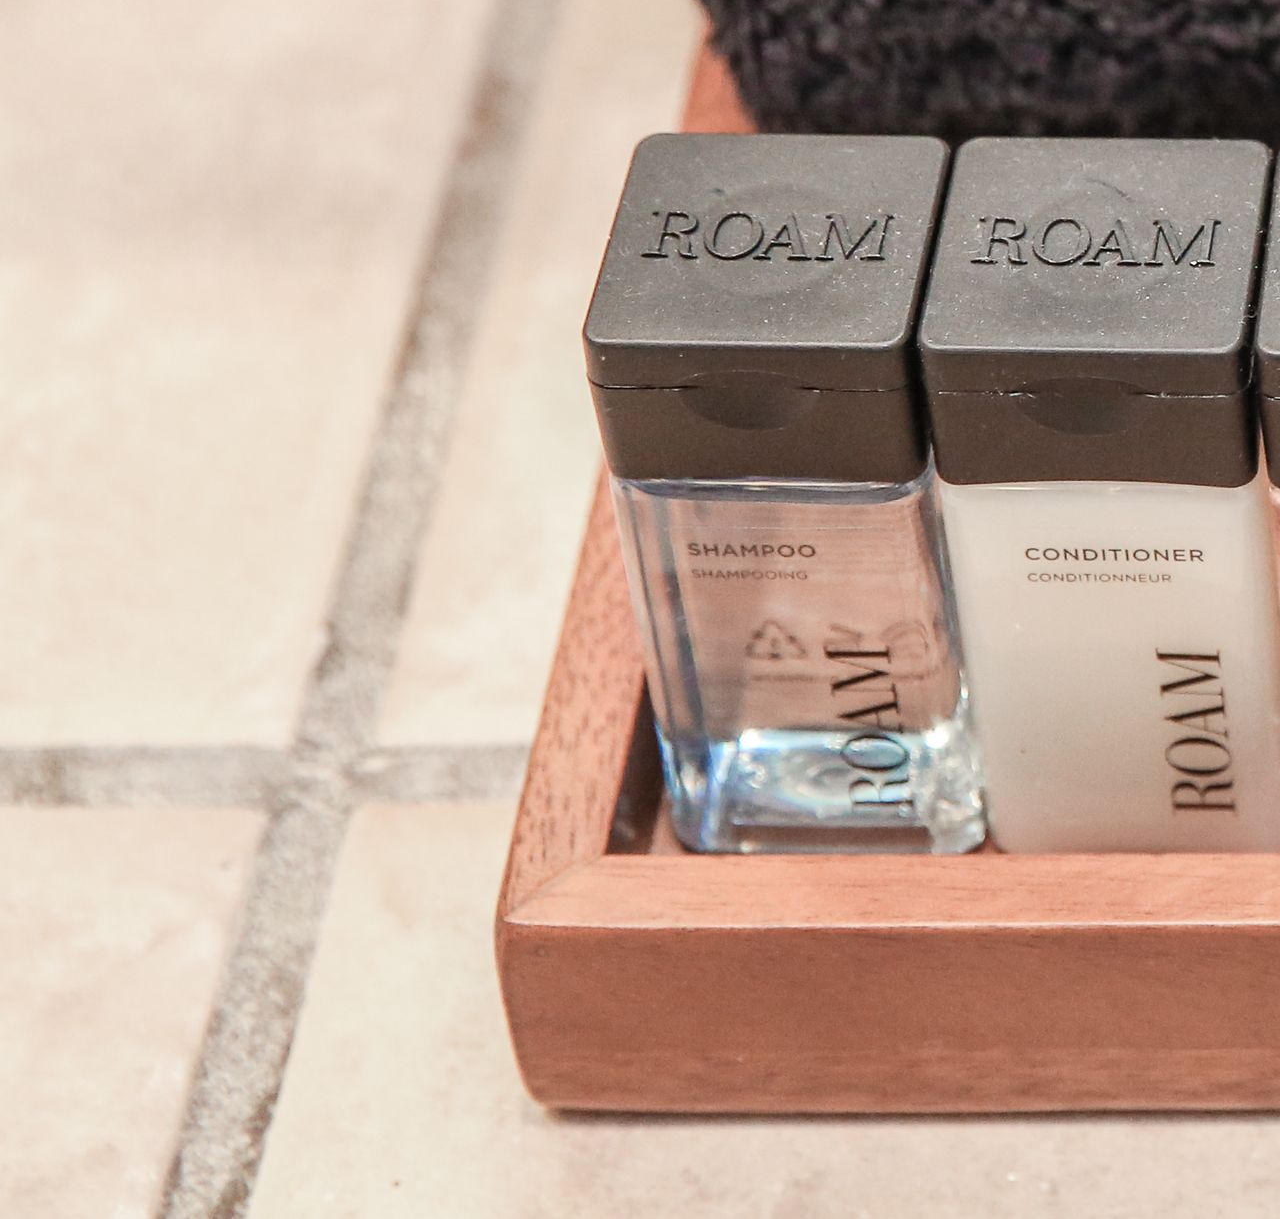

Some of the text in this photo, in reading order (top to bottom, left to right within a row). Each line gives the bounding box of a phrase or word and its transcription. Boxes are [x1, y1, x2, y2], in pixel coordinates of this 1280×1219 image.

[640, 210, 894, 262] ROAM
[970, 217, 1223, 268] ROAM
[687, 542, 816, 558] SHAMPOO
[1025, 547, 1204, 562] CONDITIONER
[691, 569, 808, 581] SHAMPOOING
[1027, 572, 1172, 583] CONDITIONNEUR
[823, 645, 914, 813] ROAM
[1156, 647, 1238, 815] ROAM
